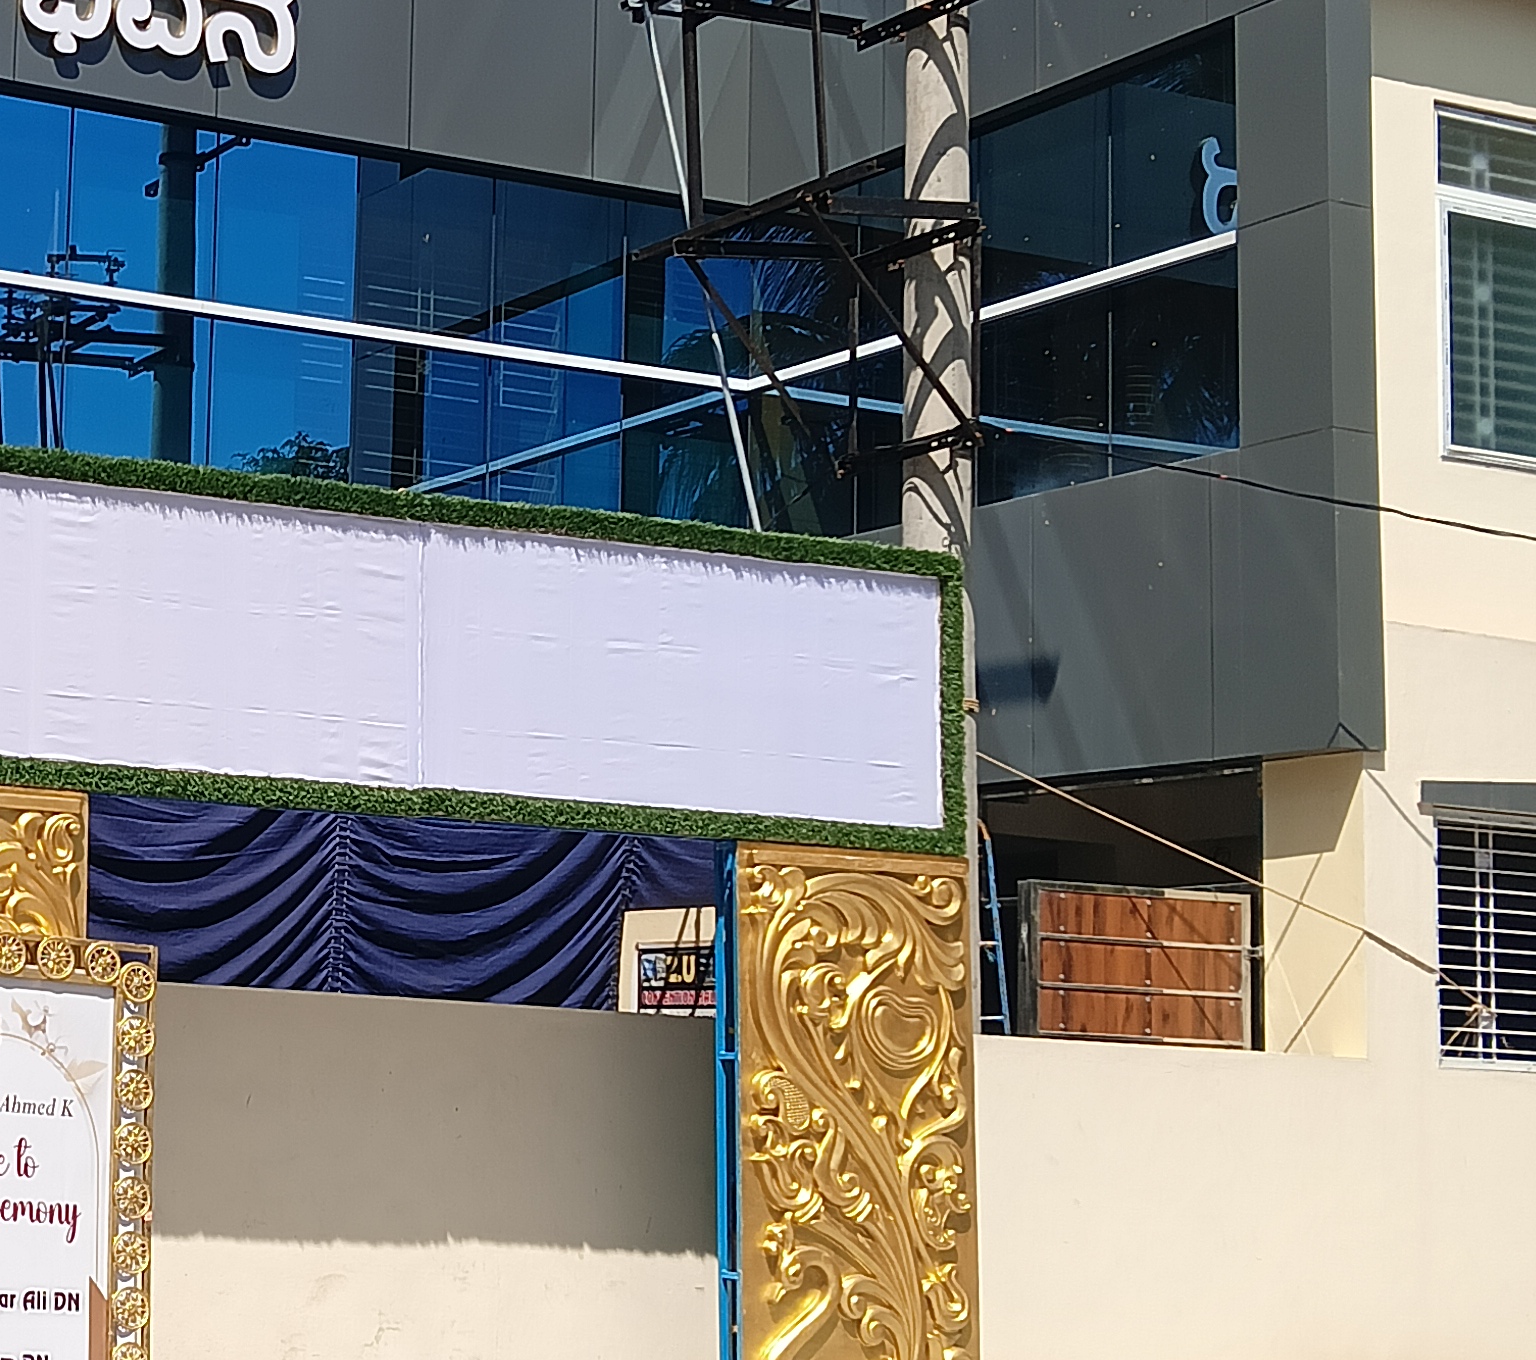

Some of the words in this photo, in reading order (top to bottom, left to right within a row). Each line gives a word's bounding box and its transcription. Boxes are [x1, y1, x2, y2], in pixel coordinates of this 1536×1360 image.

[61, 1099, 74, 1117] K
[13, 1137, 40, 1178] to
[22, 1290, 47, 1311] Ali
[53, 1292, 80, 1312] DN
